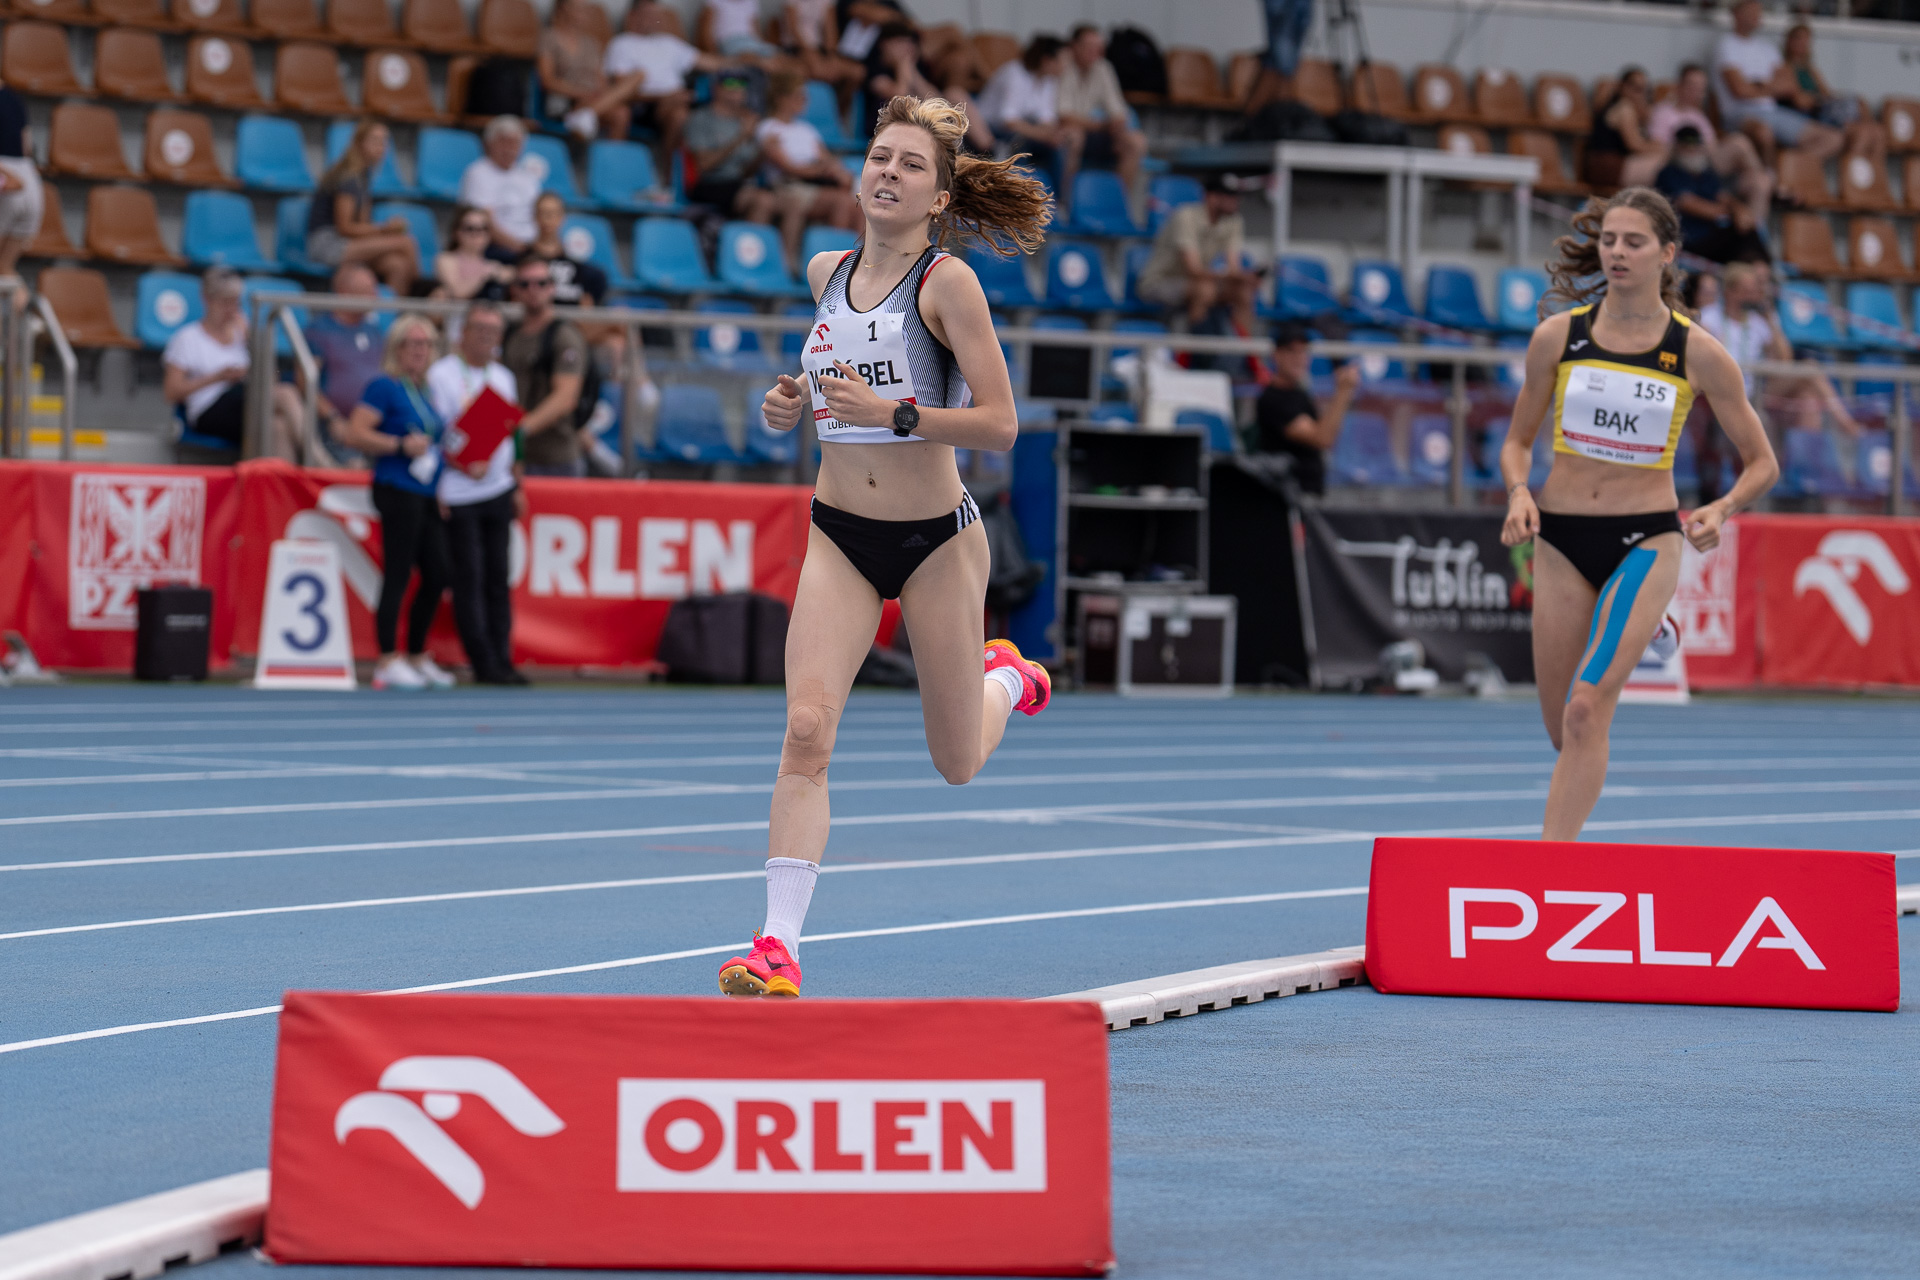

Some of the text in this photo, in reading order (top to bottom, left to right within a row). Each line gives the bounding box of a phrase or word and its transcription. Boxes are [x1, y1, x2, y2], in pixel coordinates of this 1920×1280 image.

[811, 344, 832, 354] ORLEN
[867, 321, 877, 342] 1
[1634, 380, 1667, 402] 155
[1593, 407, 1639, 436] BĄK
[508, 513, 754, 600] RLEN
[282, 570, 329, 653] 3
[1448, 886, 1827, 971] PZLA
[643, 1097, 1015, 1173] ORLEN
